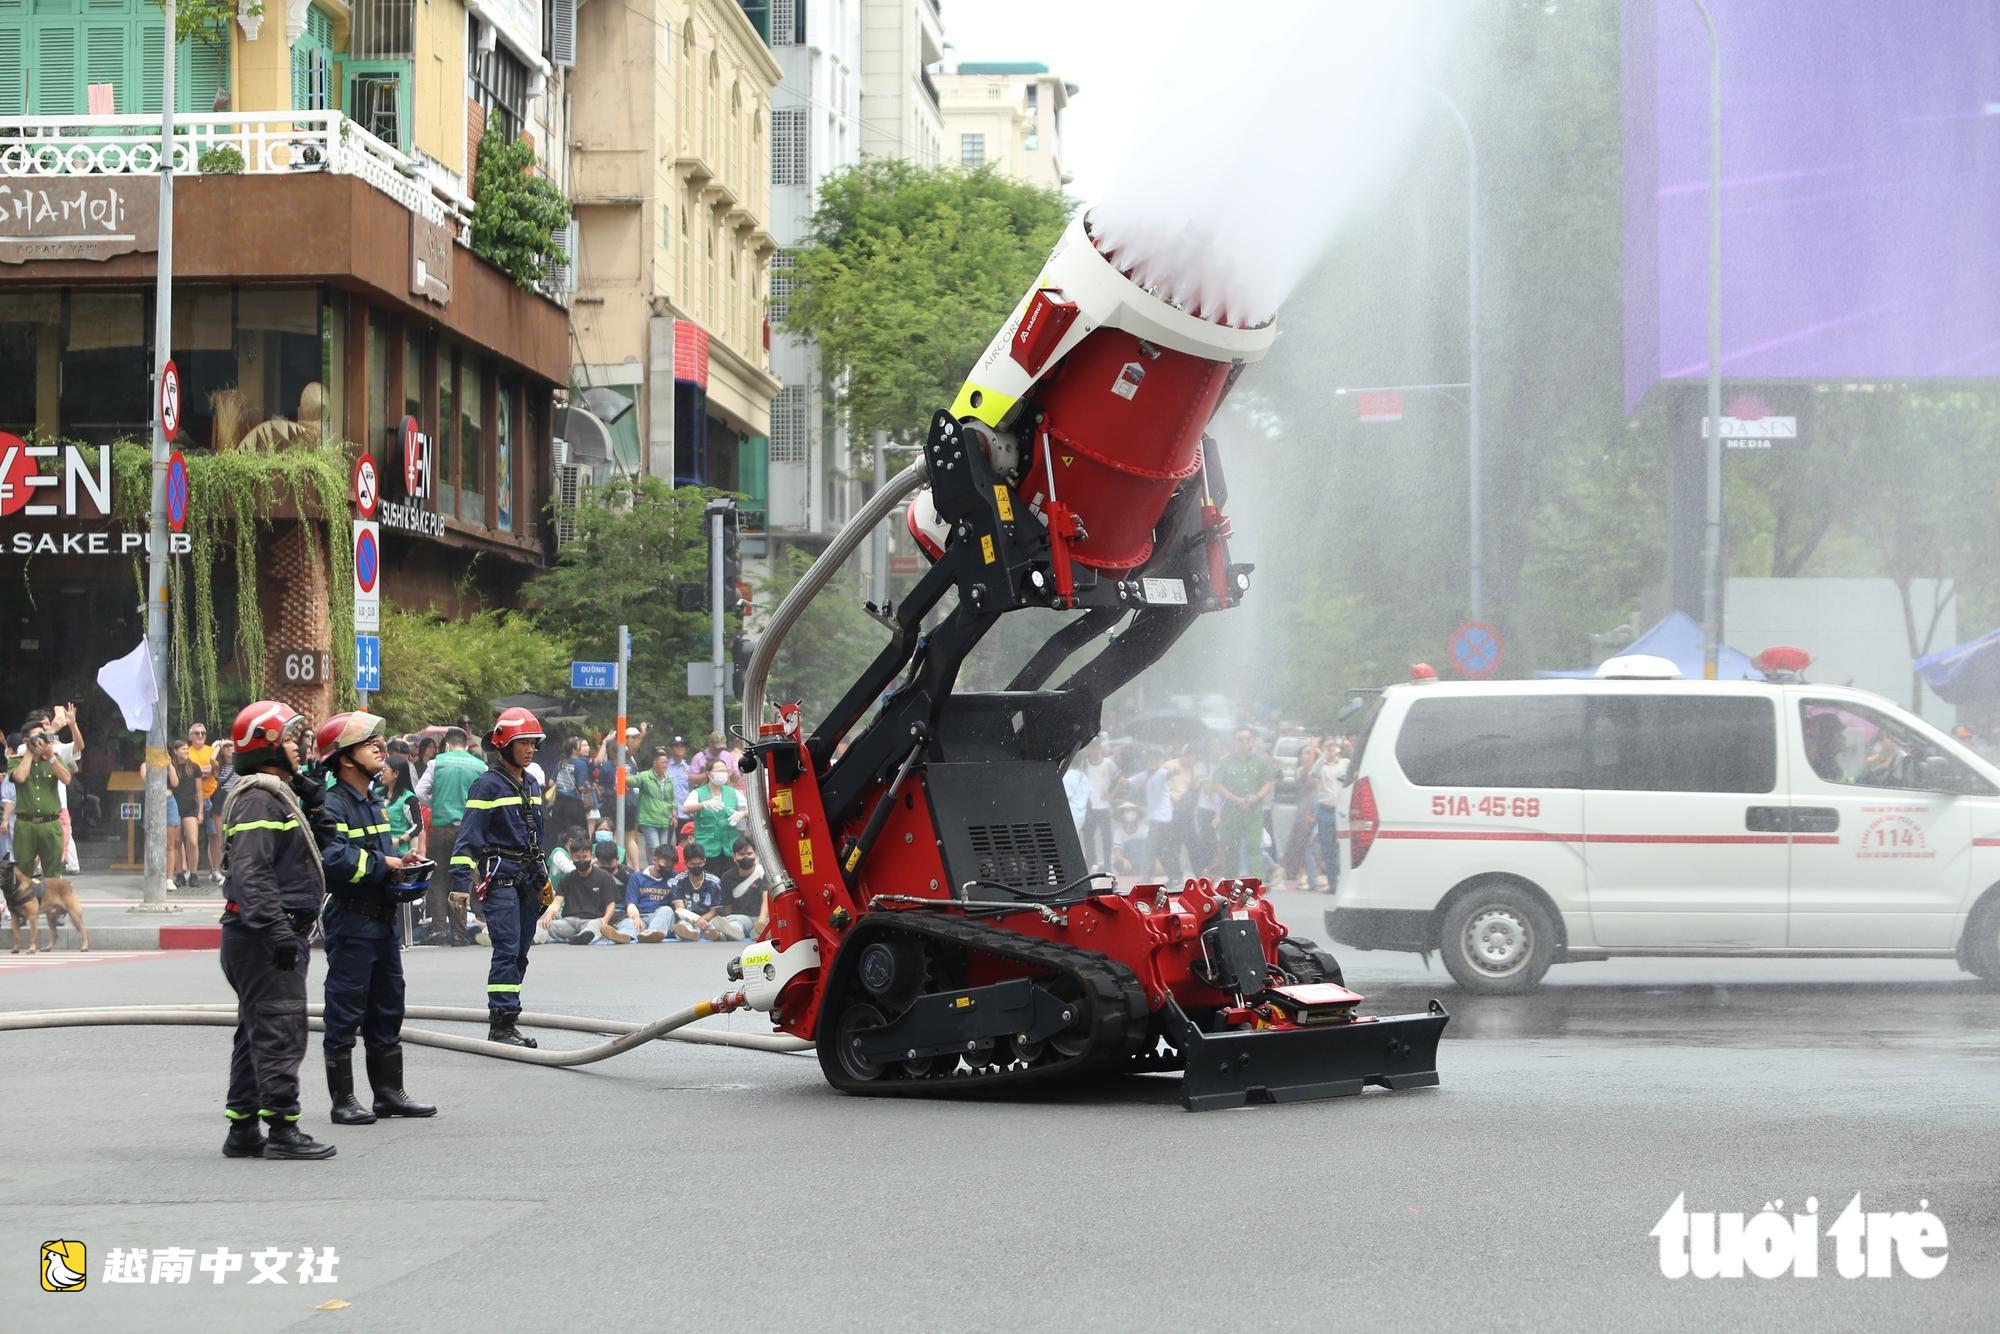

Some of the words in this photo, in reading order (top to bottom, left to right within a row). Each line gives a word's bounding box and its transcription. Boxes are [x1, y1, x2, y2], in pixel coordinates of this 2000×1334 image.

[1027, 302, 1043, 331] MAGIRUS
[984, 317, 1021, 372] AIRCORE
[1727, 439, 1771, 448] MEDIA
[382, 501, 405, 528] SUSHI
[404, 507, 409, 530] &
[410, 508, 429, 534] SAKE
[430, 512, 445, 537] PUB
[12, 532, 110, 554] SAKE
[285, 653, 315, 681] 68
[1876, 829, 1914, 847] 114
